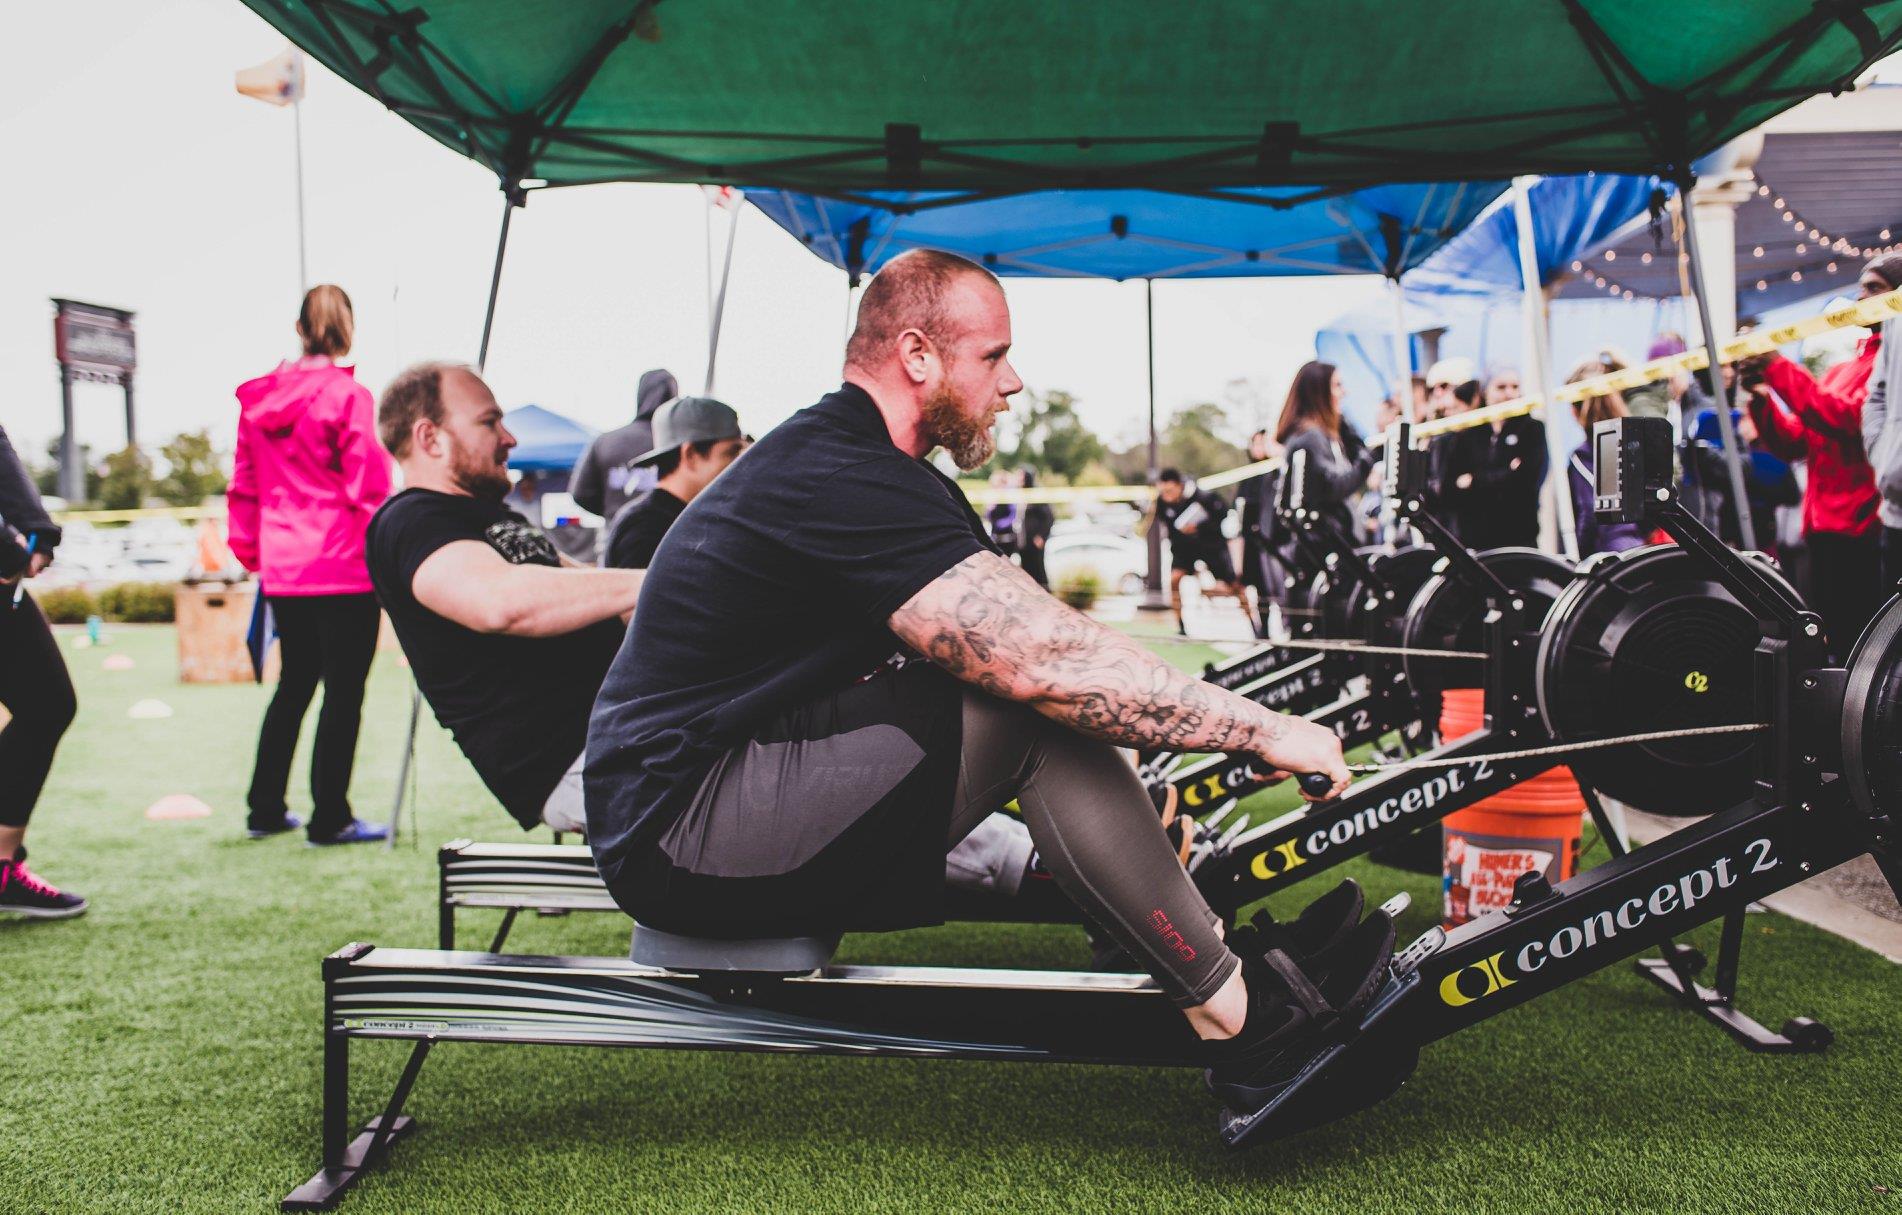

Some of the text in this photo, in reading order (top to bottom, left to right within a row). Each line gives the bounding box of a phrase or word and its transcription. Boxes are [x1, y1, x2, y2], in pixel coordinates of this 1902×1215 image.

[1352, 709, 1372, 732] 2
[1306, 768, 1466, 855] concept
[1469, 760, 1495, 782] 2
[1517, 856, 1739, 972] concept
[1744, 838, 1779, 875] 2
